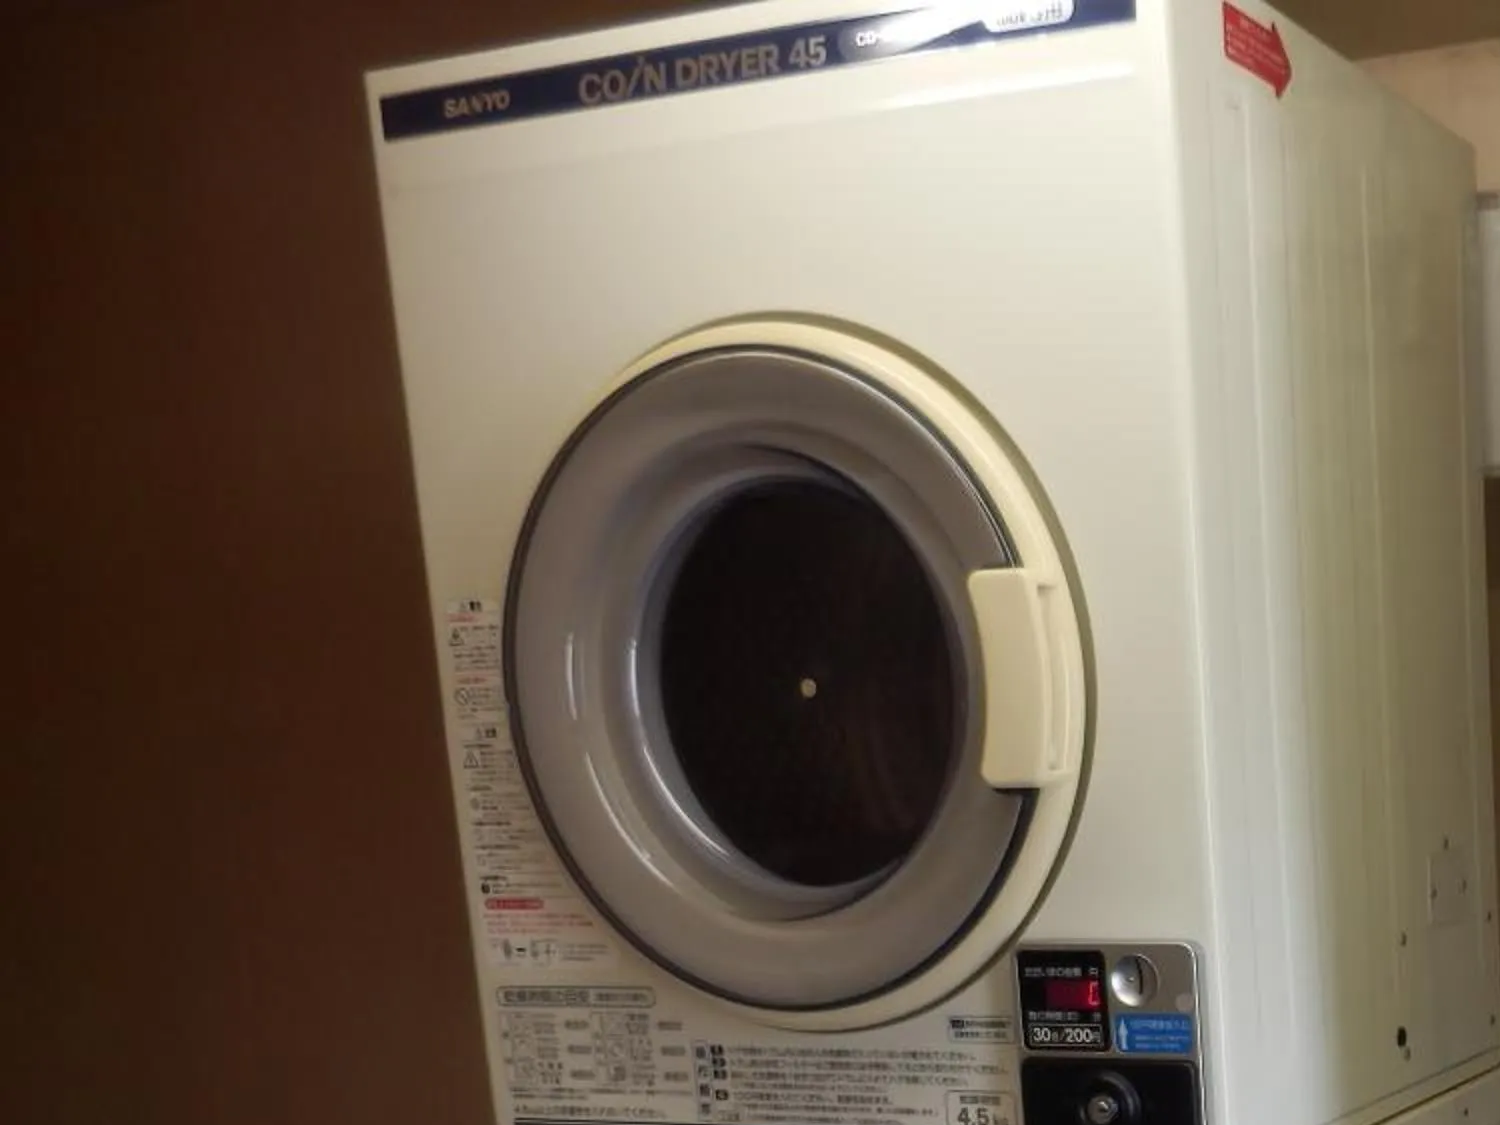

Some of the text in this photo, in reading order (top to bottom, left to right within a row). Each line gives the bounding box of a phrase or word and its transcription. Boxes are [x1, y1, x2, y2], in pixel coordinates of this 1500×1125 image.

[674, 43, 780, 88] DRYER
[788, 35, 827, 69] 45
[443, 90, 510, 119] SANYO
